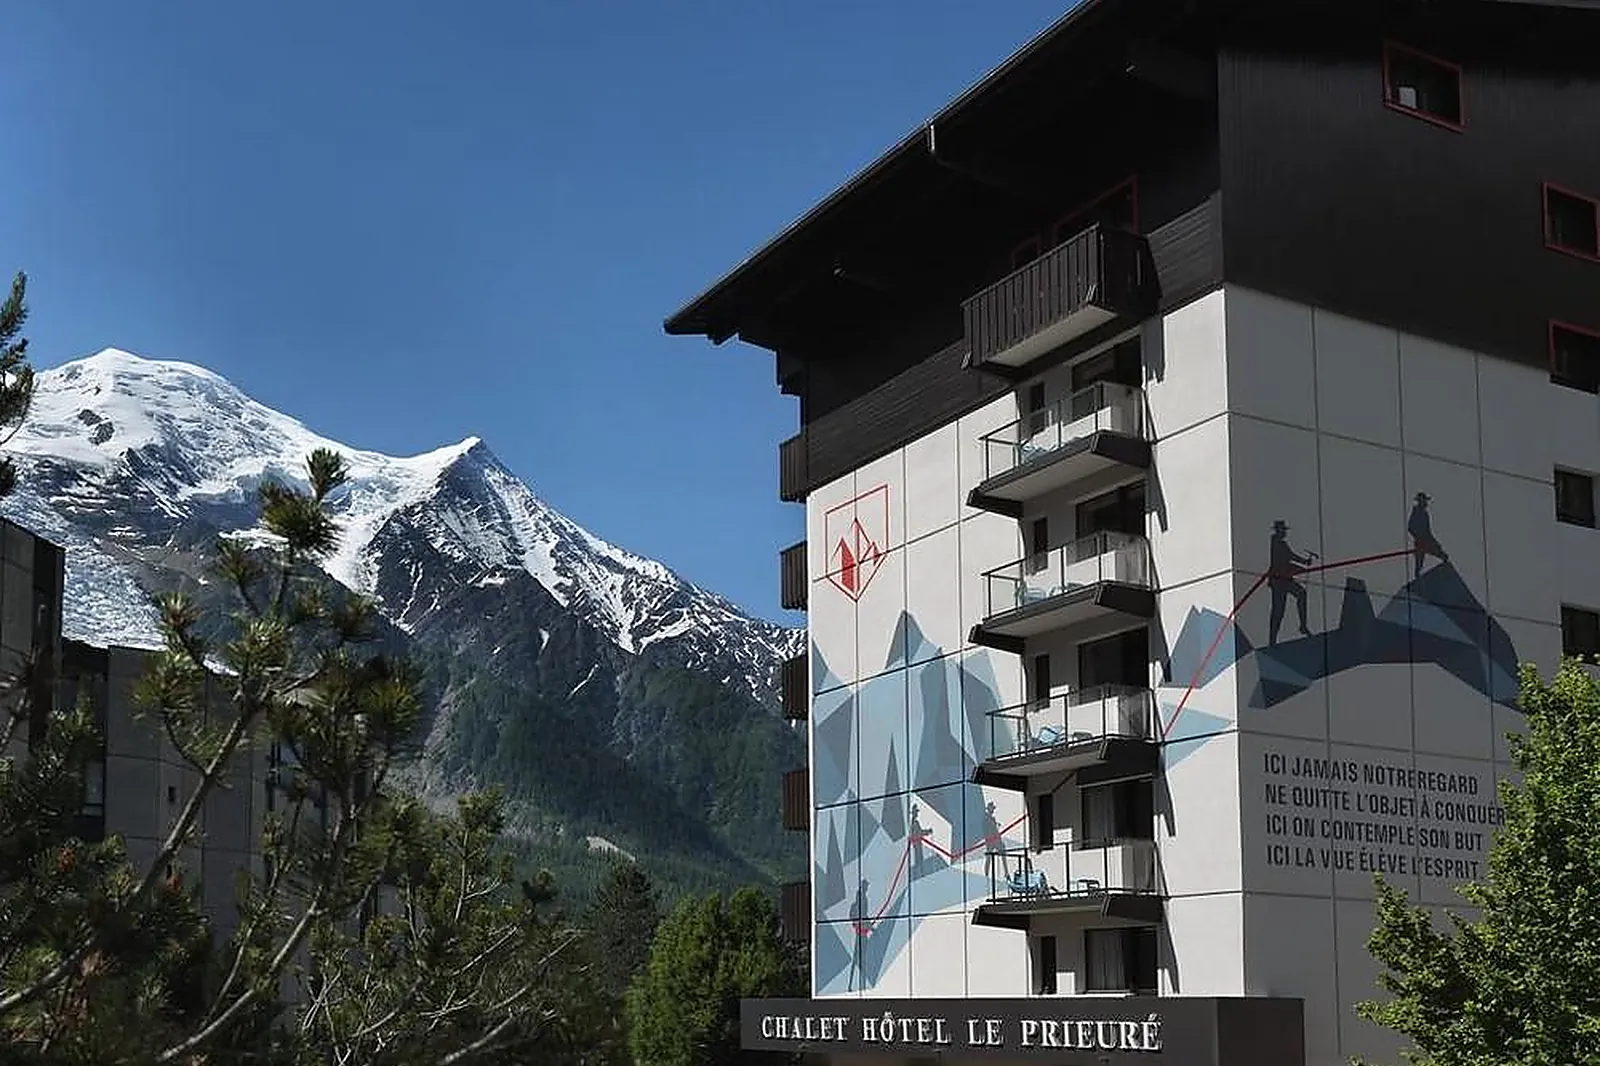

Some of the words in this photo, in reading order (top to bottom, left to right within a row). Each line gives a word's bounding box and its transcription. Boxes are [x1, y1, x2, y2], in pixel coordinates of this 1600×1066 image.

[1264, 753, 1286, 774] ICI
[1292, 757, 1357, 782] JAMAIS
[1265, 783, 1287, 804] NE
[1293, 786, 1350, 811] QUITTE
[1357, 791, 1415, 817] L'OBJET
[1420, 794, 1430, 819] À
[1266, 814, 1286, 835] ICI
[1293, 816, 1314, 838] ON
[1321, 820, 1414, 846] CONTEMPLE
[1419, 827, 1449, 849] SON
[1455, 831, 1482, 851] BUT
[1267, 845, 1289, 865] ICI
[1295, 847, 1315, 868] LA
[1320, 849, 1354, 871] VUE
[762, 1016, 849, 1041] CHALET
[967, 1019, 1004, 1045] LE
[1020, 1013, 1162, 1050] PRIEURÉ
